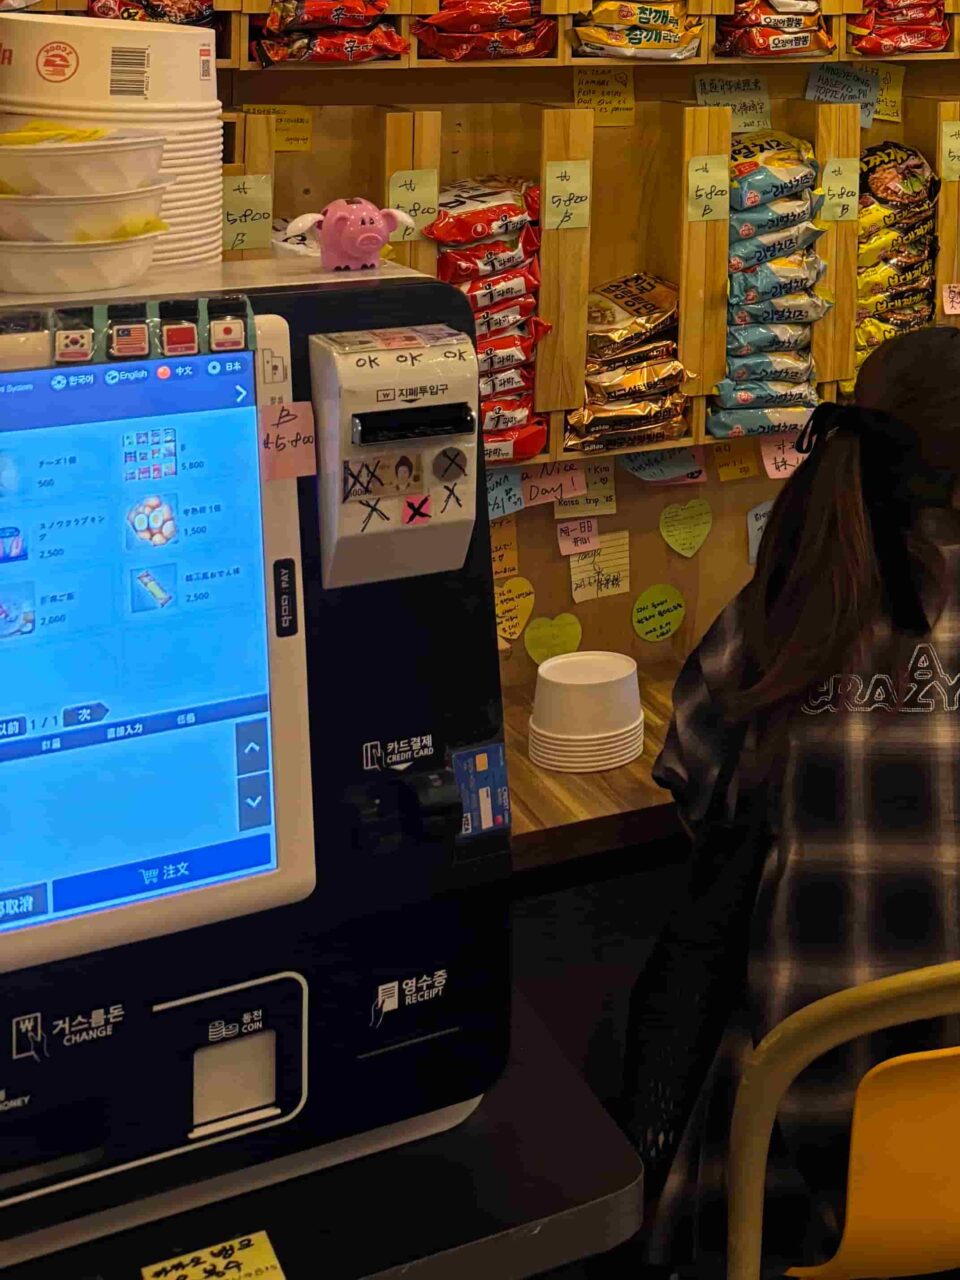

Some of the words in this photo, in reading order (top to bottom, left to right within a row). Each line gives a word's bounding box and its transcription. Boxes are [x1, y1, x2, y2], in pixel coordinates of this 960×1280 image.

[356, 355, 380, 368] OK
[396, 351, 424, 367] OK
[444, 349, 468, 362] OK
[120, 368, 148, 381] English
[176, 366, 193, 377] 中文
[225, 361, 242, 372] 日本
[69, 374, 94, 387] 한국어
[398, 383, 448, 399] 지폐투입구
[78, 708, 91, 721] 次
[387, 734, 433, 753] 카드결제
[386, 750, 413, 763] CREDIT
[413, 747, 434, 758] CARD
[163, 861, 190, 880] 注文
[402, 970, 448, 995] 영수증
[404, 986, 444, 1006] RECEIPT
[52, 1004, 125, 1036] 거스름돈
[241, 1021, 263, 1034] COIN
[63, 1024, 113, 1047] CHANGE
